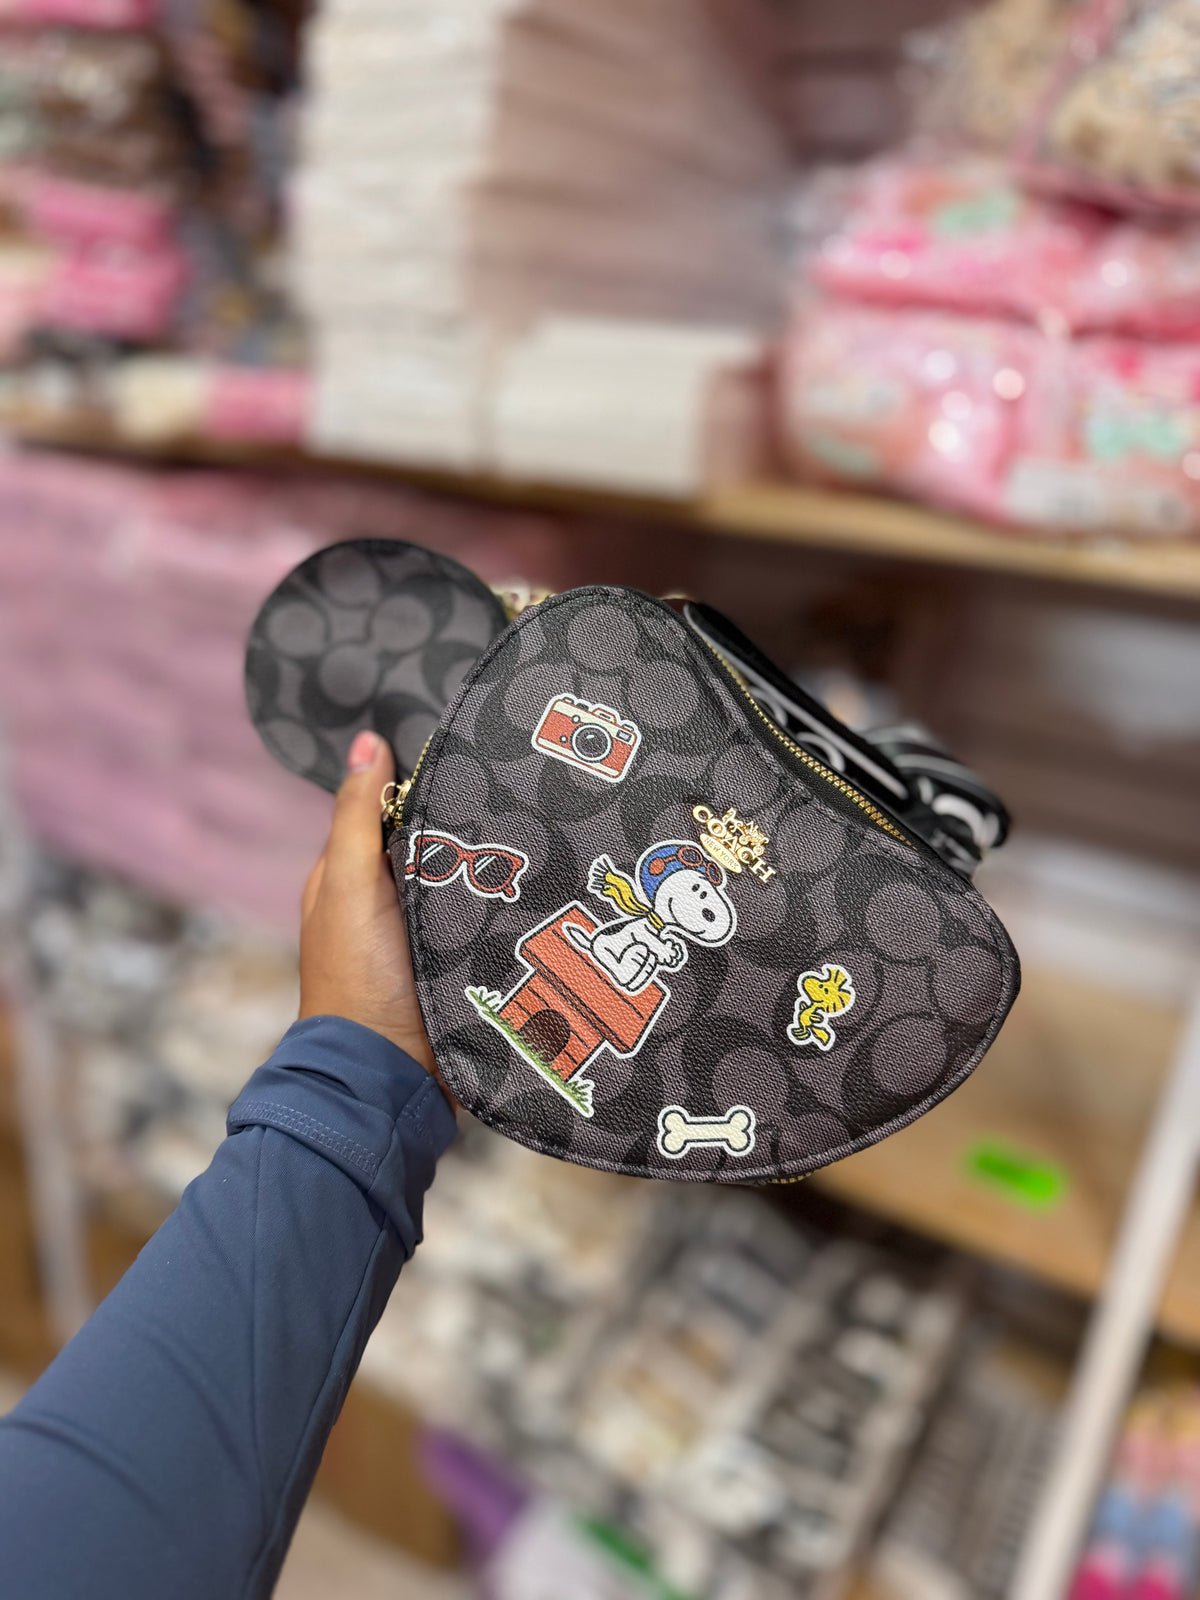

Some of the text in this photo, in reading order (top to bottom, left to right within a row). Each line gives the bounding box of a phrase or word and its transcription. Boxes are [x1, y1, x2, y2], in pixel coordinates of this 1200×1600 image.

[692, 805, 776, 883] COACH
[703, 836, 739, 870] NEW YORK
